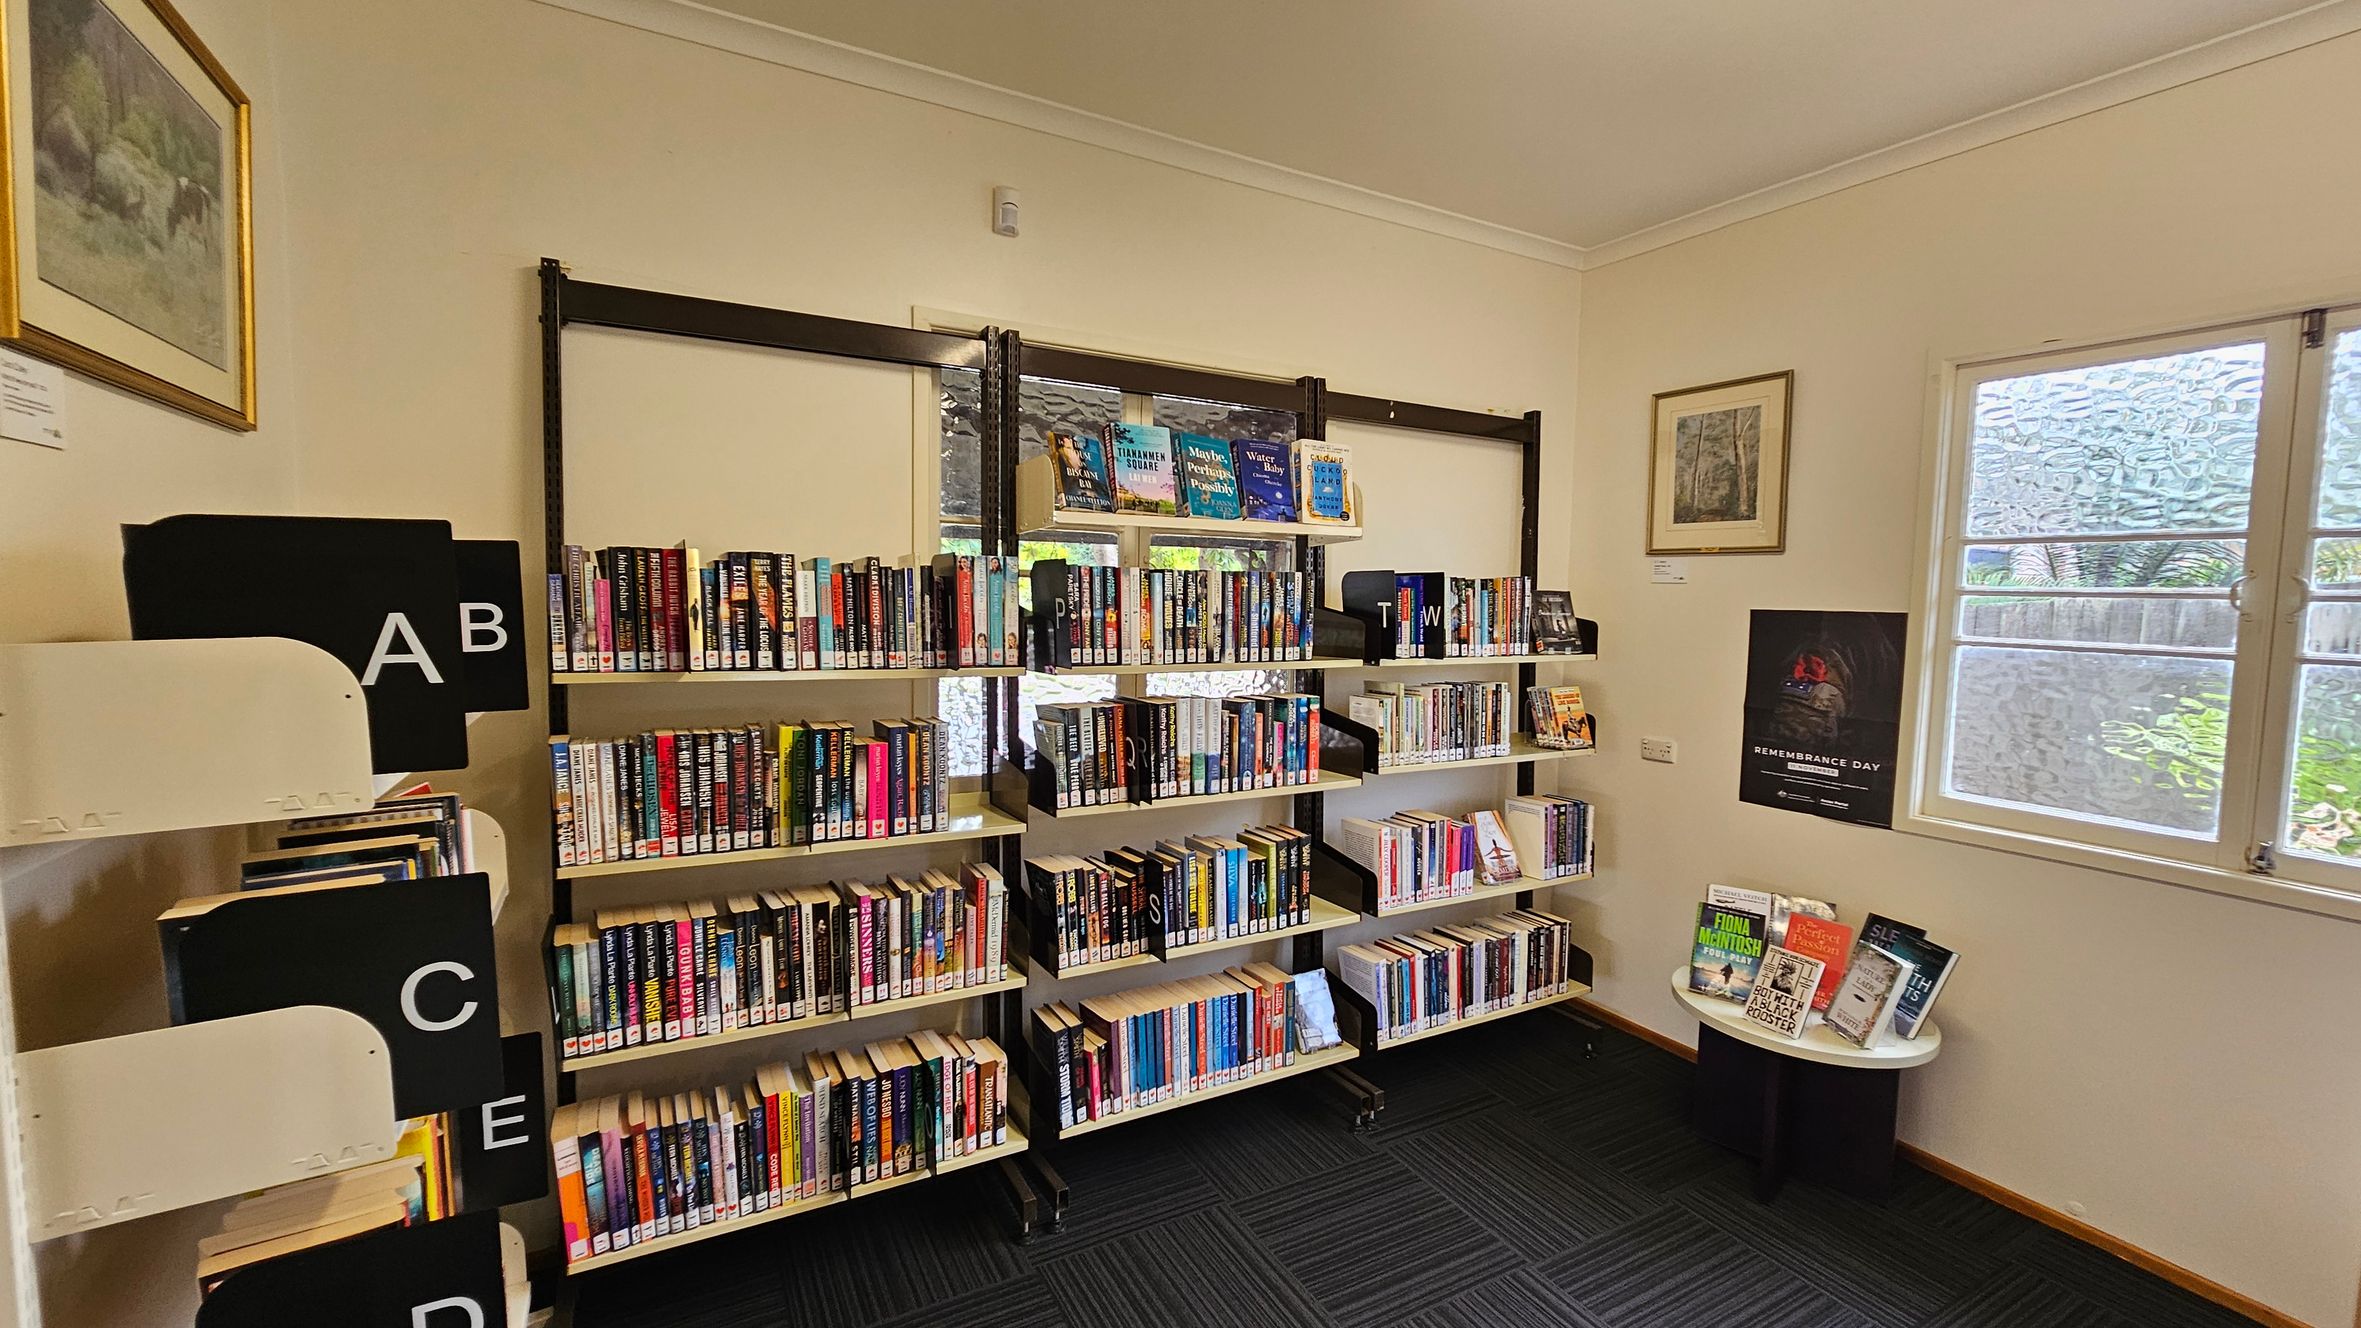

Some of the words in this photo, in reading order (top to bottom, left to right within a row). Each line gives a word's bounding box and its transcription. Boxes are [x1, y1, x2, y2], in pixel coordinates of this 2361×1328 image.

[1118, 448, 1165, 462] TIANANMEN
[1189, 446, 1228, 464] Maybe,
[1246, 451, 1275, 464] Water
[1310, 454, 1344, 463] CLOUD
[1127, 460, 1158, 471] SQUARE
[1188, 463, 1235, 480] Perhaps,
[1264, 462, 1285, 476] Baby
[1307, 464, 1348, 475] CUCKOO
[1143, 474, 1157, 484] WEN
[1191, 478, 1235, 496] Possibly
[1315, 477, 1341, 485] LAND
[1211, 499, 1237, 507] JOANNA
[618, 552, 628, 573] John
[637, 557, 645, 583] LAUREN
[781, 556, 791, 576] THE
[668, 570, 677, 591] RABBIT
[732, 566, 747, 597] EXILES
[758, 575, 767, 587] THE
[619, 575, 628, 611] Grisham
[651, 578, 662, 607] COLUMN
[758, 589, 767, 605] YEAR
[782, 579, 793, 618] FLAMES
[670, 595, 679, 614] HUTCH
[872, 591, 880, 625] DIVISION
[1056, 598, 1065, 629] P
[736, 608, 745, 622] JANE
[759, 618, 767, 629] THE
[1378, 602, 1391, 628] T
[1423, 606, 1441, 627] W
[460, 602, 508, 652] B
[737, 625, 746, 649] HARPER
[361, 613, 443, 686] A
[555, 753, 567, 767] J.A.
[619, 746, 627, 767] DIANE
[698, 746, 711, 763] IRIS
[1755, 746, 1847, 767] REMEMBRANCE
[1852, 761, 1880, 771] DAY
[1798, 765, 1836, 775] NOVEMBER
[634, 776, 642, 797] JECKS
[699, 766, 711, 807] JOHANSEN
[661, 808, 670, 839] JEWELL
[669, 814, 677, 831] LISA
[1713, 889, 1741, 898] MICHAEL
[1149, 894, 1160, 924] S
[663, 924, 673, 944] Lynda
[707, 920, 716, 947] DENNIS
[1714, 912, 1749, 936] FIONA
[1795, 923, 1840, 944] Perfect
[1807, 920, 1818, 928] The
[604, 931, 614, 951] Lynda
[624, 927, 634, 947] Lynda
[645, 925, 654, 945] Lynda
[695, 926, 704, 943] JOHN
[862, 915, 872, 973] SINNERS
[1699, 927, 1761, 957] McINTOSH
[627, 948, 634, 958] La
[647, 946, 654, 956] La
[666, 945, 673, 955] La
[696, 945, 704, 953] LE
[1793, 934, 1839, 956] Passion
[607, 952, 614, 961] La
[680, 947, 690, 982] GUNK
[708, 950, 716, 977] LEHANE
[736, 945, 744, 968] Leon
[749, 944, 759, 969] Leon
[1703, 946, 1725, 957] FOUL
[1729, 954, 1752, 965] PLAY
[627, 959, 635, 980] Plante
[666, 956, 674, 976] Plante
[1858, 964, 1885, 985] NATURE
[1856, 977, 1875, 992] LADY
[401, 961, 478, 1032] C
[1753, 985, 1773, 998] BOY
[1775, 993, 1804, 1011] WITH
[1751, 996, 1758, 1005] A
[1760, 998, 1798, 1022] BLACK
[1746, 1006, 1796, 1034] ROOSTER
[1837, 1012, 1859, 1031] WHITE
[882, 1080, 890, 1090] JO
[945, 1084, 951, 1094] OF
[1060, 1063, 1070, 1097] STORM
[867, 1080, 876, 1104] WEB
[984, 1077, 993, 1130] TRANSATLANTIC
[482, 1095, 529, 1150] E
[866, 1106, 874, 1123] OF
[867, 1125, 876, 1143] LIES
